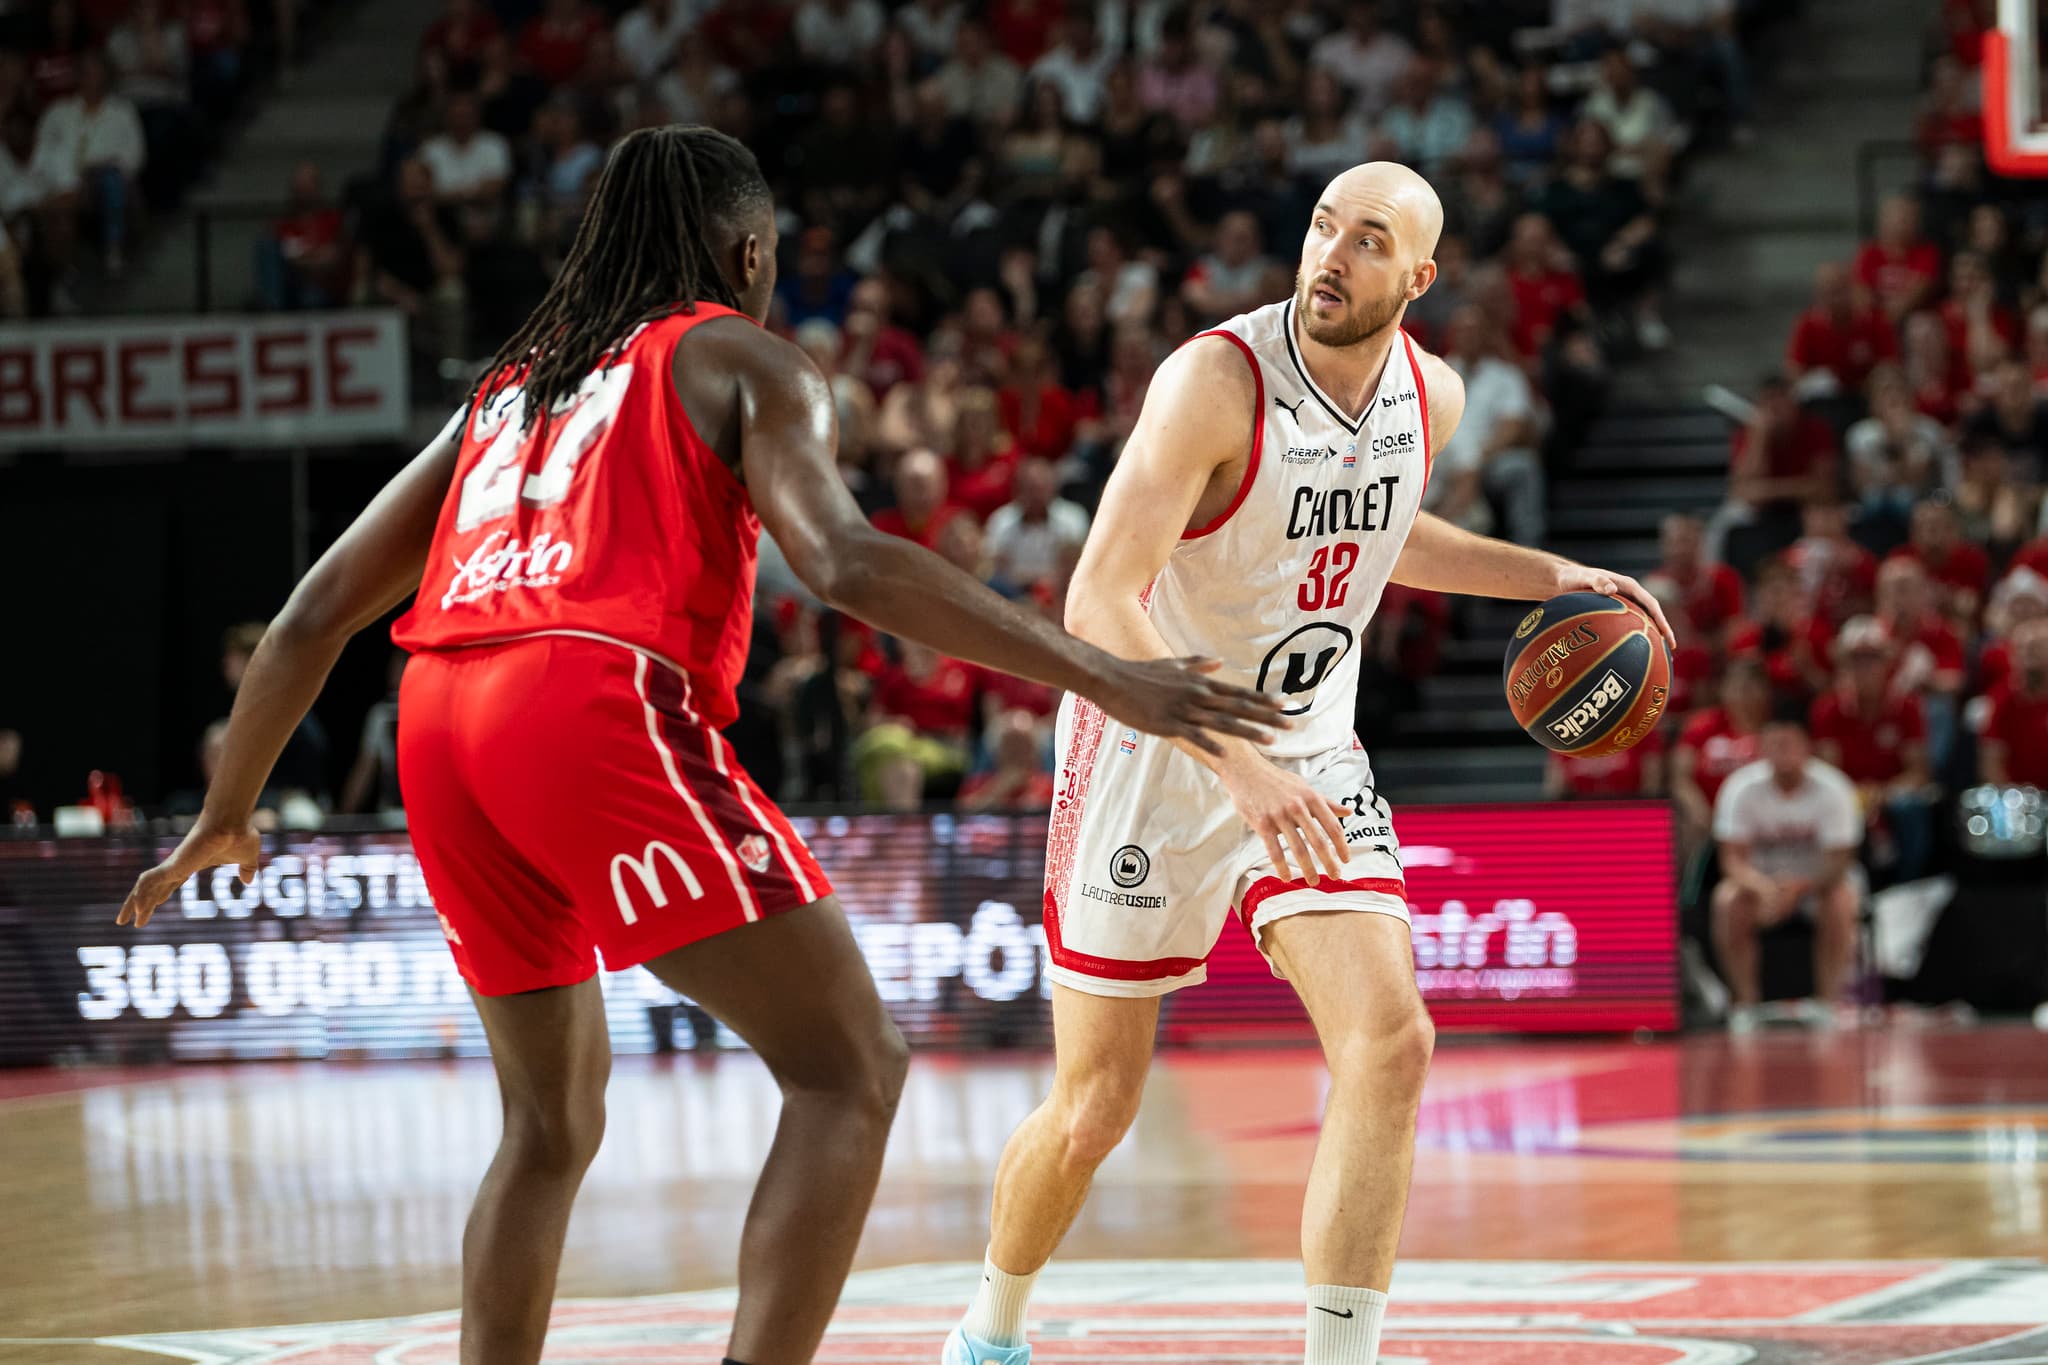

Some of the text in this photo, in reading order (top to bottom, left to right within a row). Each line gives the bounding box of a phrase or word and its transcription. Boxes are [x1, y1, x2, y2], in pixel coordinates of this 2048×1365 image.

[0, 327, 384, 428] BRESSE
[456, 362, 633, 534] 27
[1286, 476, 1399, 540] CHOLET
[1297, 542, 1360, 612] 32
[1511, 620, 1600, 709] SPALDING
[1553, 674, 1624, 740] Betclic
[181, 854, 434, 919] LOGISTI
[77, 945, 232, 1020] 300
[245, 942, 403, 1016] 000
